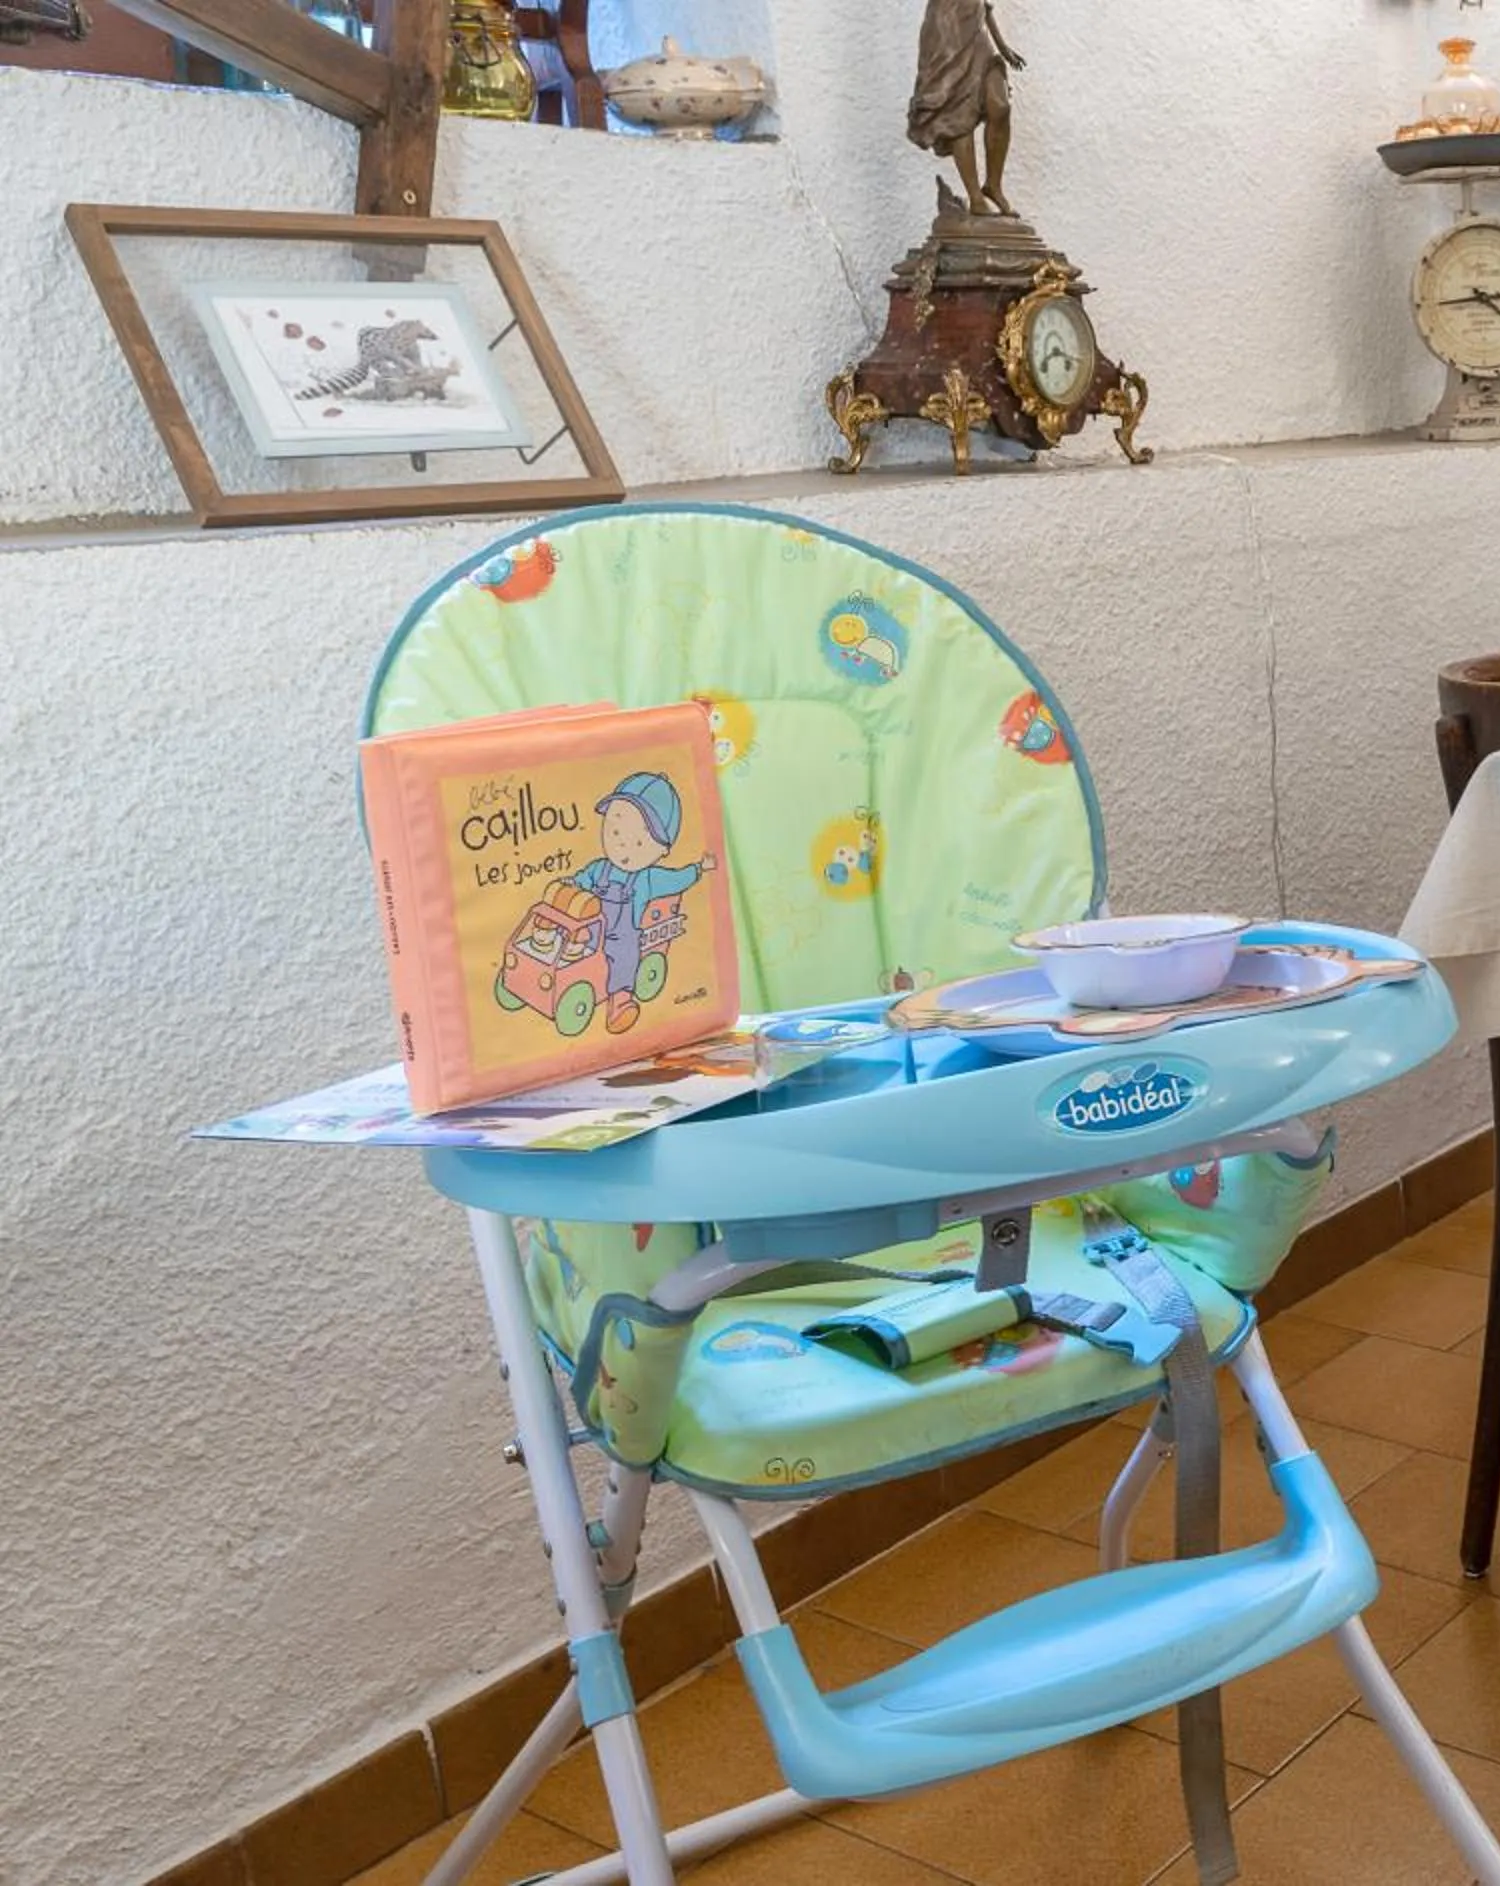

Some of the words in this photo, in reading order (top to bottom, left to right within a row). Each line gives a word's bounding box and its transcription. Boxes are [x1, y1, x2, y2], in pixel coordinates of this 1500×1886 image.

[475, 863, 509, 887] Les
[514, 849, 572, 885] jouets
[1069, 1077, 1181, 1126] babidéal
